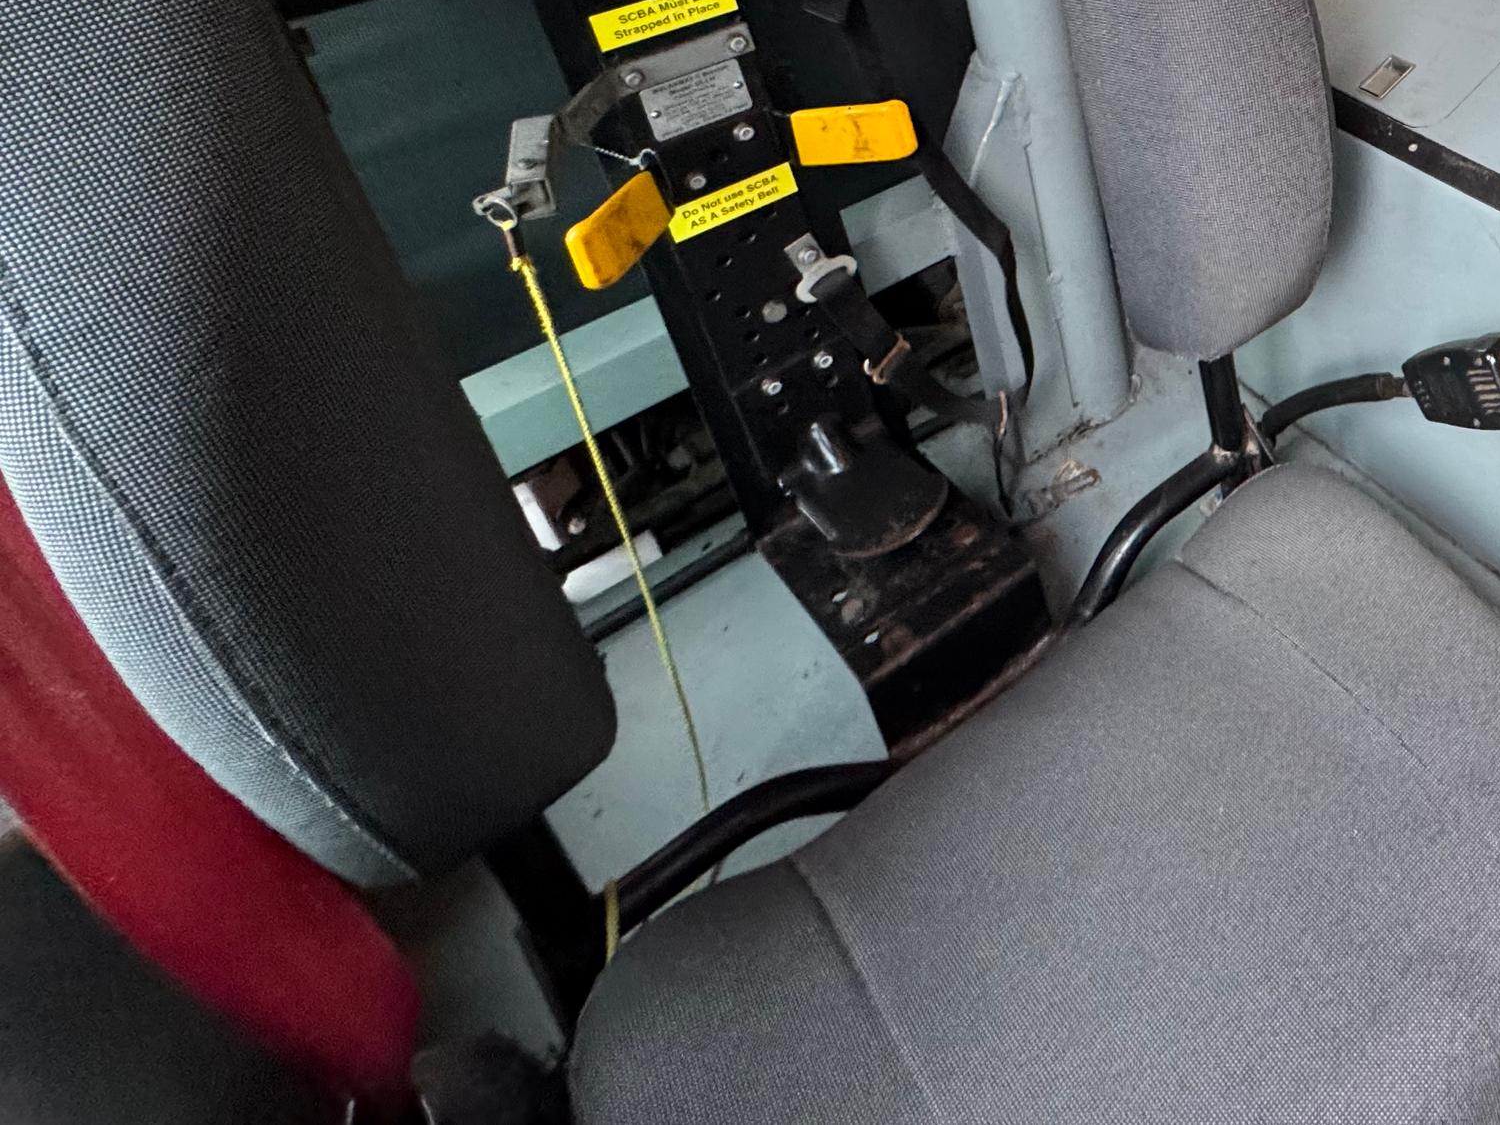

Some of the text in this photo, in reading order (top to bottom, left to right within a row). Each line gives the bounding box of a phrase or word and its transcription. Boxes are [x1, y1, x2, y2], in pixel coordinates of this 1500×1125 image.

[614, 1, 720, 40] Strapped in Place
[618, 7, 657, 24] SCBA
[682, 174, 779, 219] Do Not use SCBA
[690, 186, 780, 229] AS A Safety Belt
